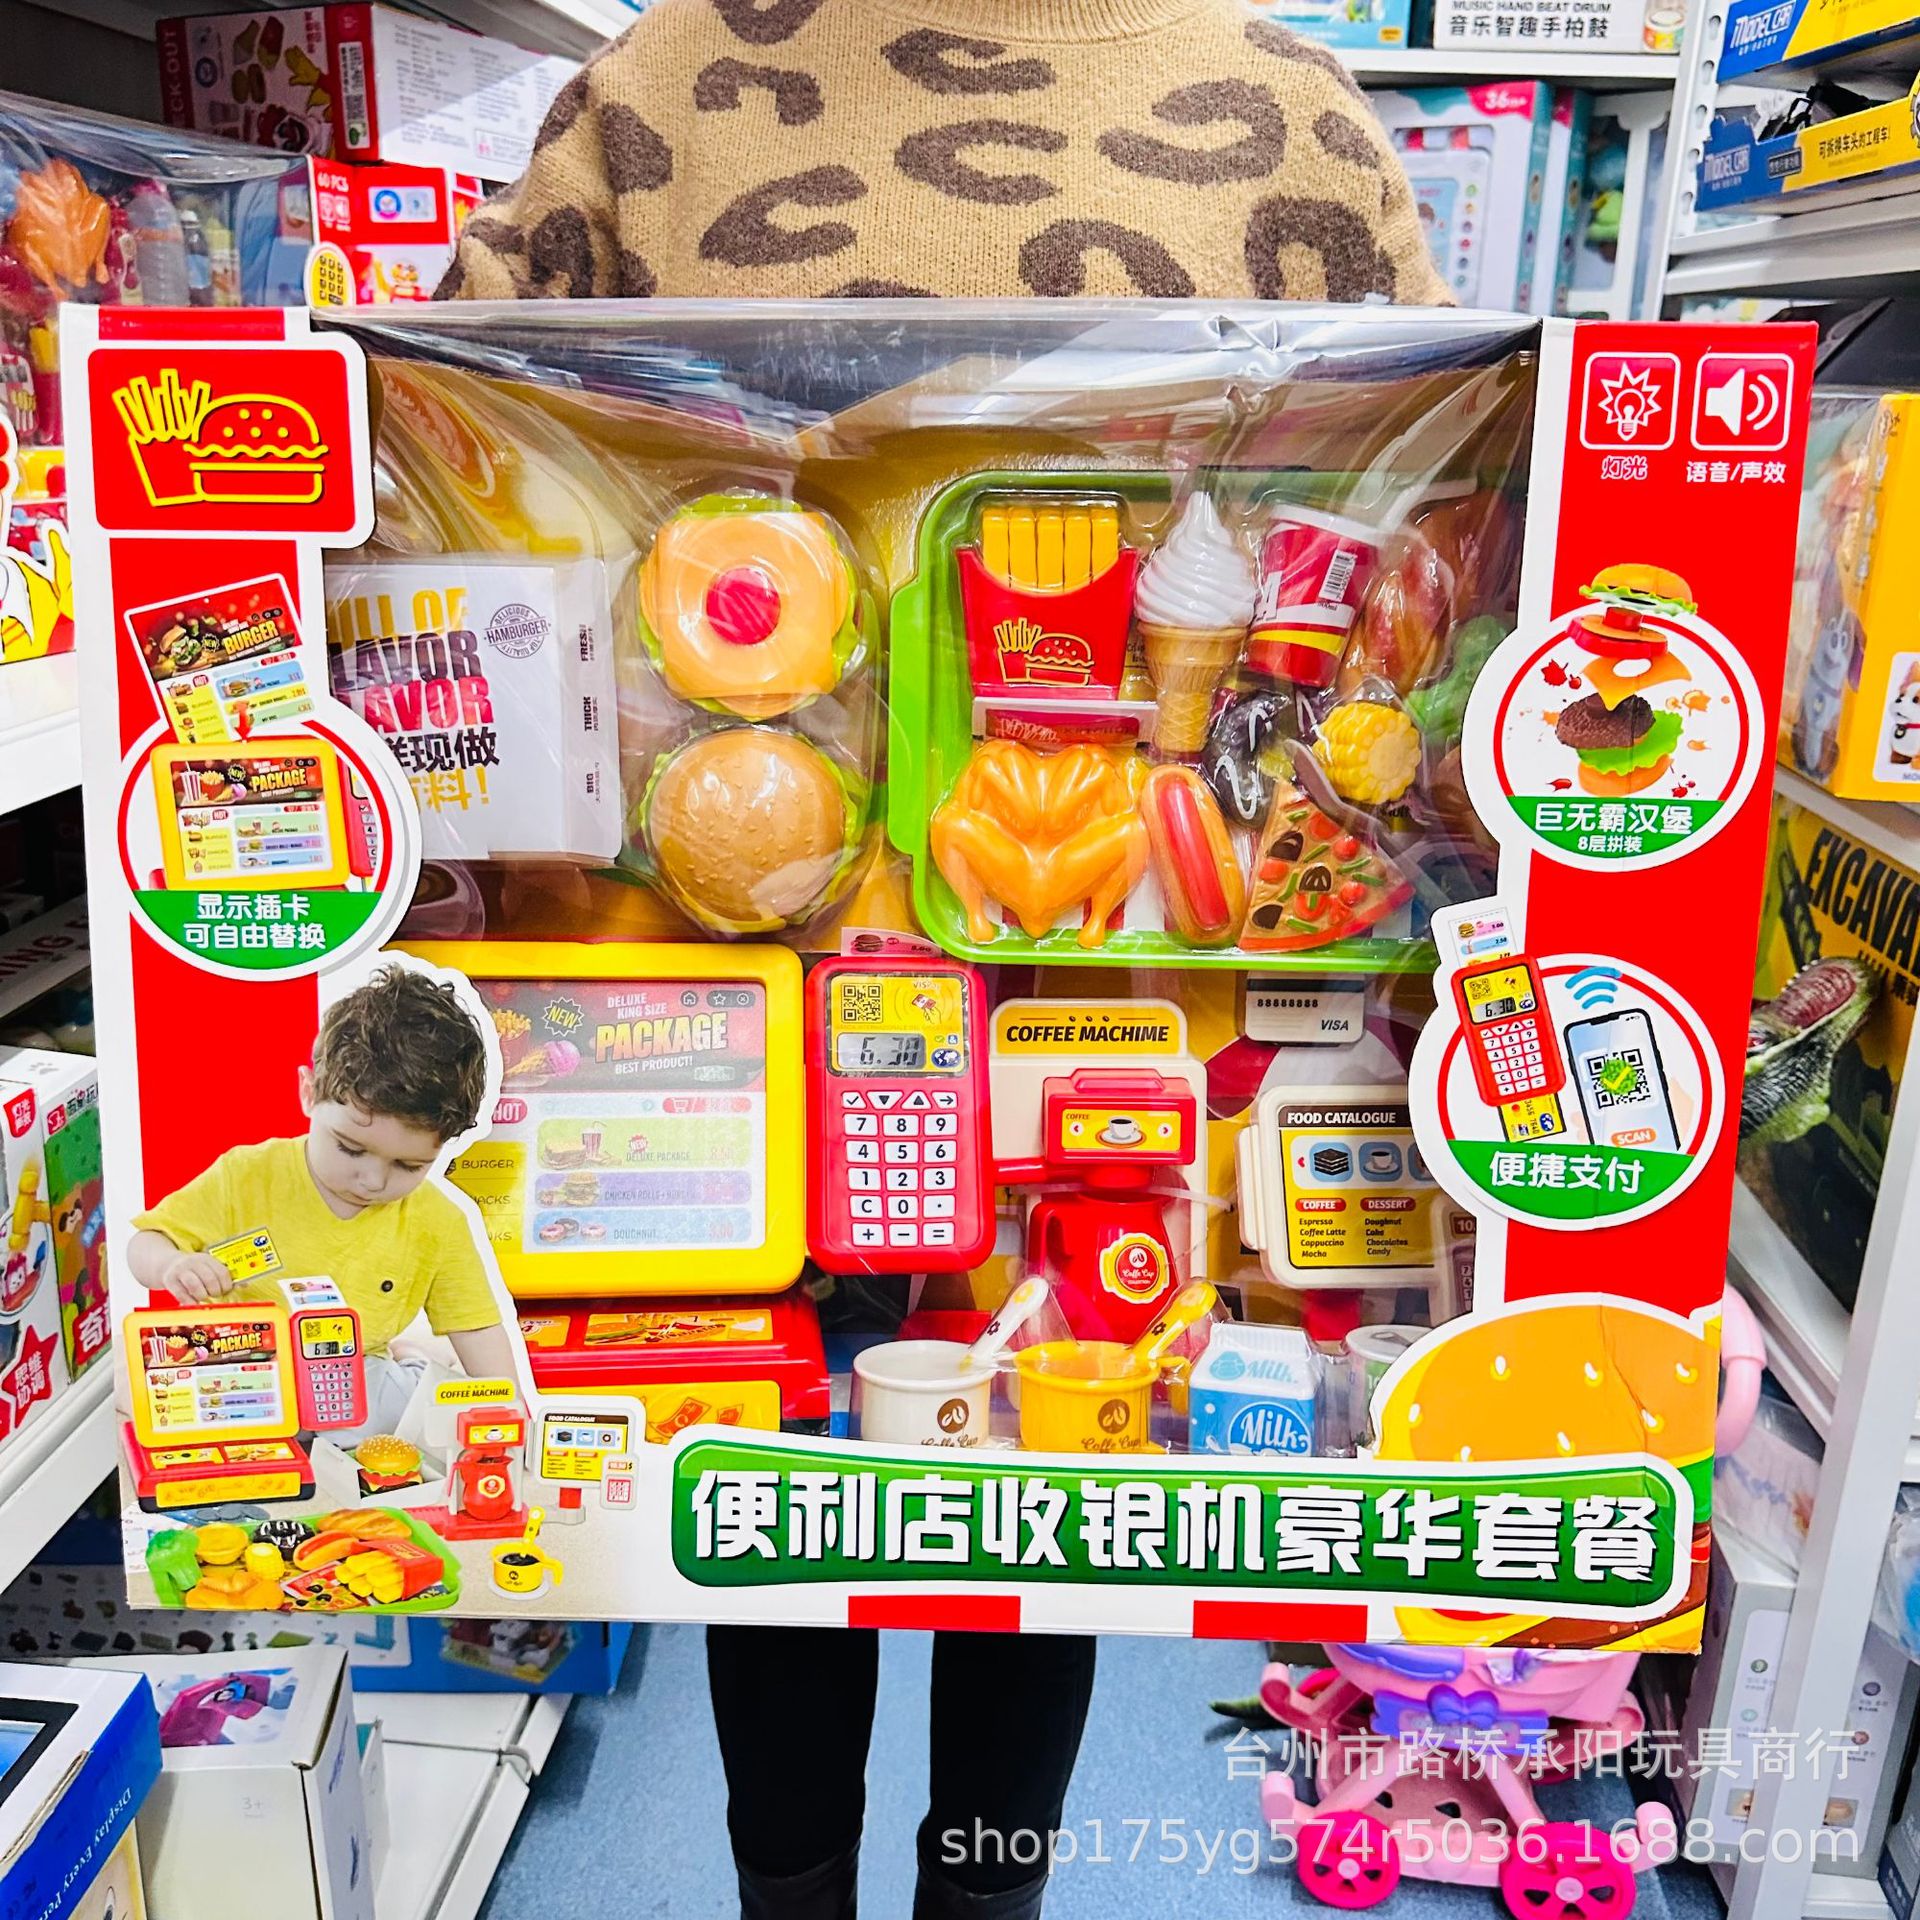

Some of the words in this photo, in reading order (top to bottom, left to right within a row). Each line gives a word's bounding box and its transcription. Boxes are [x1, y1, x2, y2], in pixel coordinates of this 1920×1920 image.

[1450, 15, 1609, 39] 音乐智趣手拍鼓
[1601, 455, 1648, 481] 灯光
[1686, 460, 1786, 484] 语音/声效
[222, 620, 279, 656] BURGER
[486, 619, 549, 644] HAMBURGER
[348, 676, 494, 734] AVOR
[251, 768, 308, 792] PACKAGE
[1535, 802, 1693, 835] 巨无霸汉堡
[1577, 835, 1643, 854] 8层拼装
[197, 893, 311, 921] 显示插卡
[183, 923, 327, 950] 可自由替换
[607, 993, 648, 1009] DELUXE
[1485, 997, 1514, 1018] 6.30
[548, 1005, 579, 1030] NEW
[617, 1006, 643, 1020] KING
[644, 1002, 668, 1017] SIZE
[1320, 1019, 1350, 1031] VISA
[595, 1011, 728, 1063] PACKAGE
[1006, 1025, 1076, 1042] COFFEE
[615, 1059, 641, 1075] BEST
[642, 1055, 694, 1071] PRODUCT!
[493, 1102, 522, 1121] HOT
[1287, 1112, 1321, 1125] FOOD
[1323, 1111, 1397, 1125] CATALOGUE
[857, 1117, 867, 1131] 7
[896, 1118, 907, 1132] 8
[935, 1117, 946, 1131] 9
[1616, 1130, 1651, 1145] SCAN
[858, 1145, 869, 1158] 4
[897, 1145, 908, 1159] 5
[935, 1144, 946, 1158] 6
[461, 1159, 515, 1169] BURGER
[862, 1171, 869, 1185] 1
[897, 1172, 908, 1186] 2
[935, 1171, 946, 1185] 3
[1489, 1151, 1645, 1194] 便捷支付
[861, 1199, 872, 1213] C
[897, 1200, 908, 1214] 0
[1302, 1200, 1336, 1210] COFFEE
[1368, 1199, 1408, 1209] DESSERT
[1299, 1218, 1333, 1227] Espresso
[1300, 1228, 1325, 1238] Coffee
[1300, 1239, 1345, 1249] Cappuccino
[1302, 1250, 1328, 1258] Mocha
[212, 1331, 263, 1354] PACKAGE
[440, 1389, 470, 1399] COFFEE
[692, 1470, 1658, 1585] 便利店收银机豪华套餐
[94, 1787, 131, 1847] Display
[62, 1845, 93, 1893] Every
